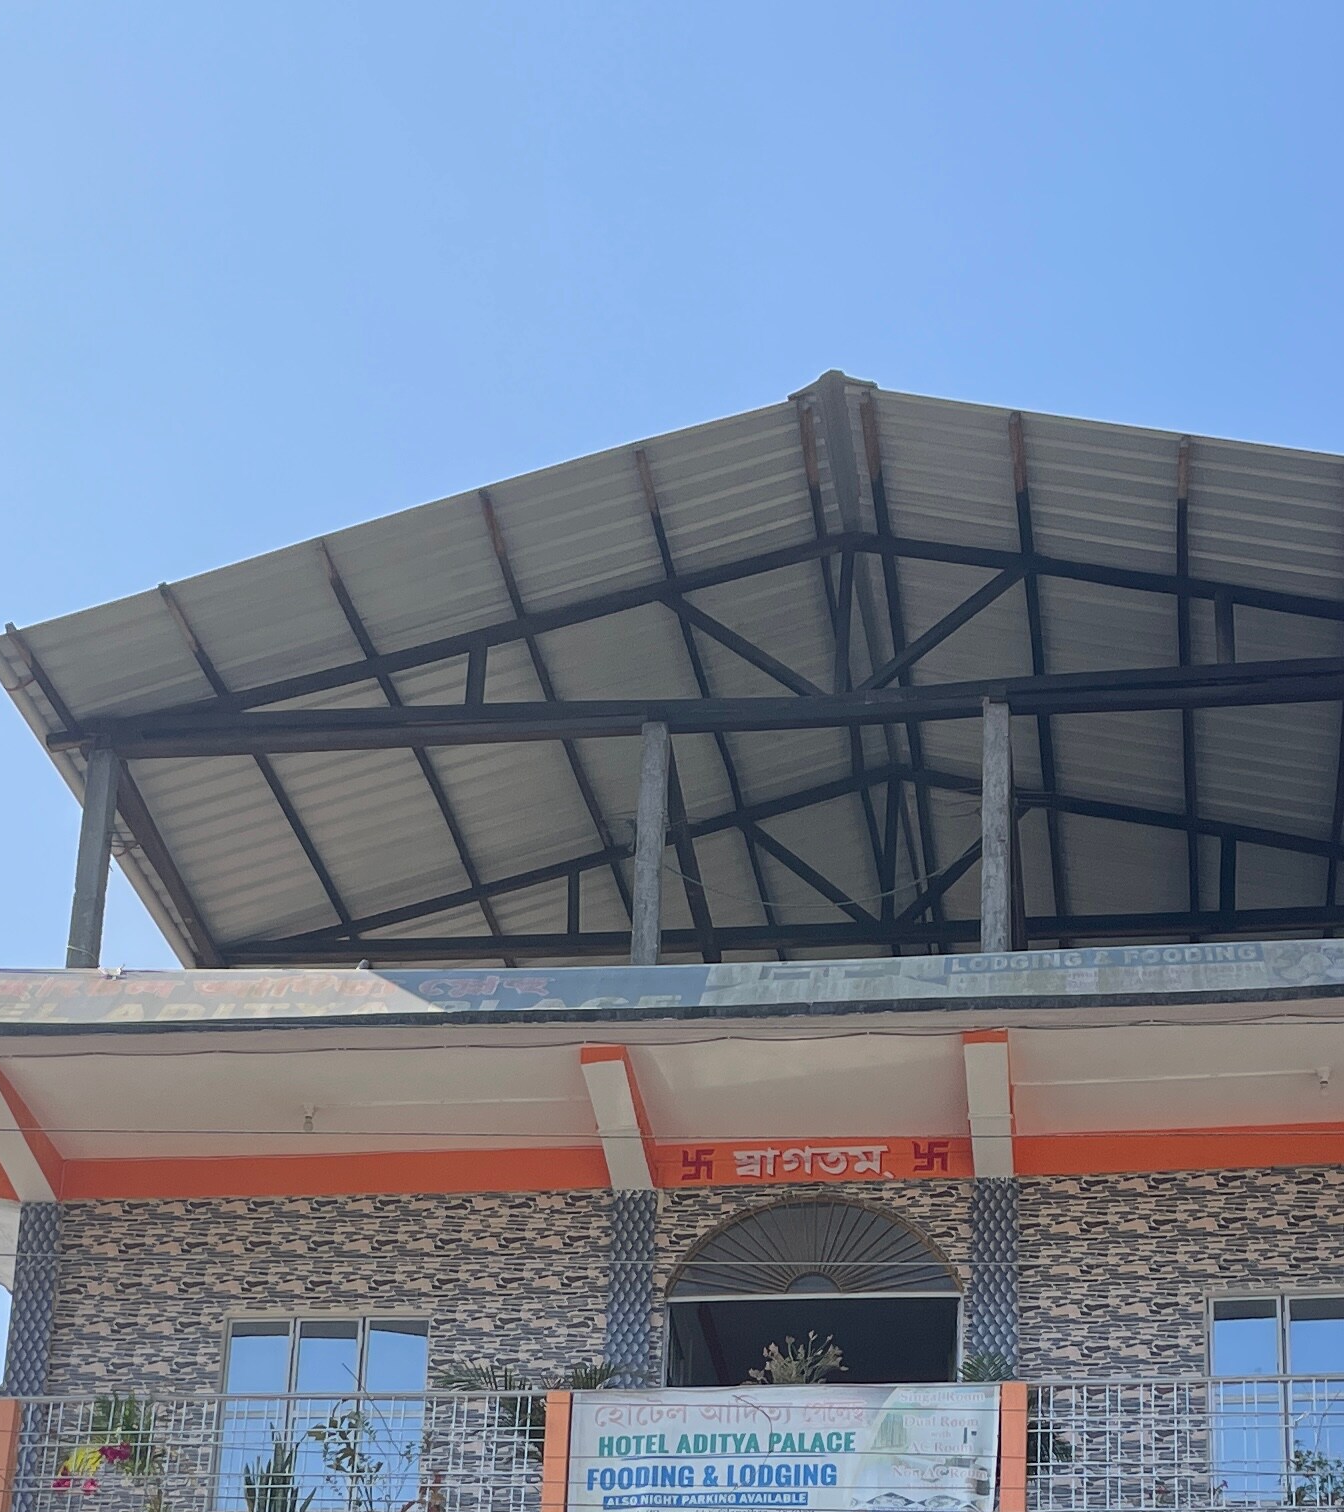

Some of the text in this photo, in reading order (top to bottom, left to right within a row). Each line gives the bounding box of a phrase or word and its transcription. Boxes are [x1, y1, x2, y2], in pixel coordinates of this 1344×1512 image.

[904, 1415, 979, 1427] Dual Room
[598, 1431, 856, 1457] HOTEL ADITYA PALACE
[586, 1464, 837, 1490] FOODING & LODGING
[607, 1493, 807, 1507] ALSO NIGHT PARKING AVAILABLE
